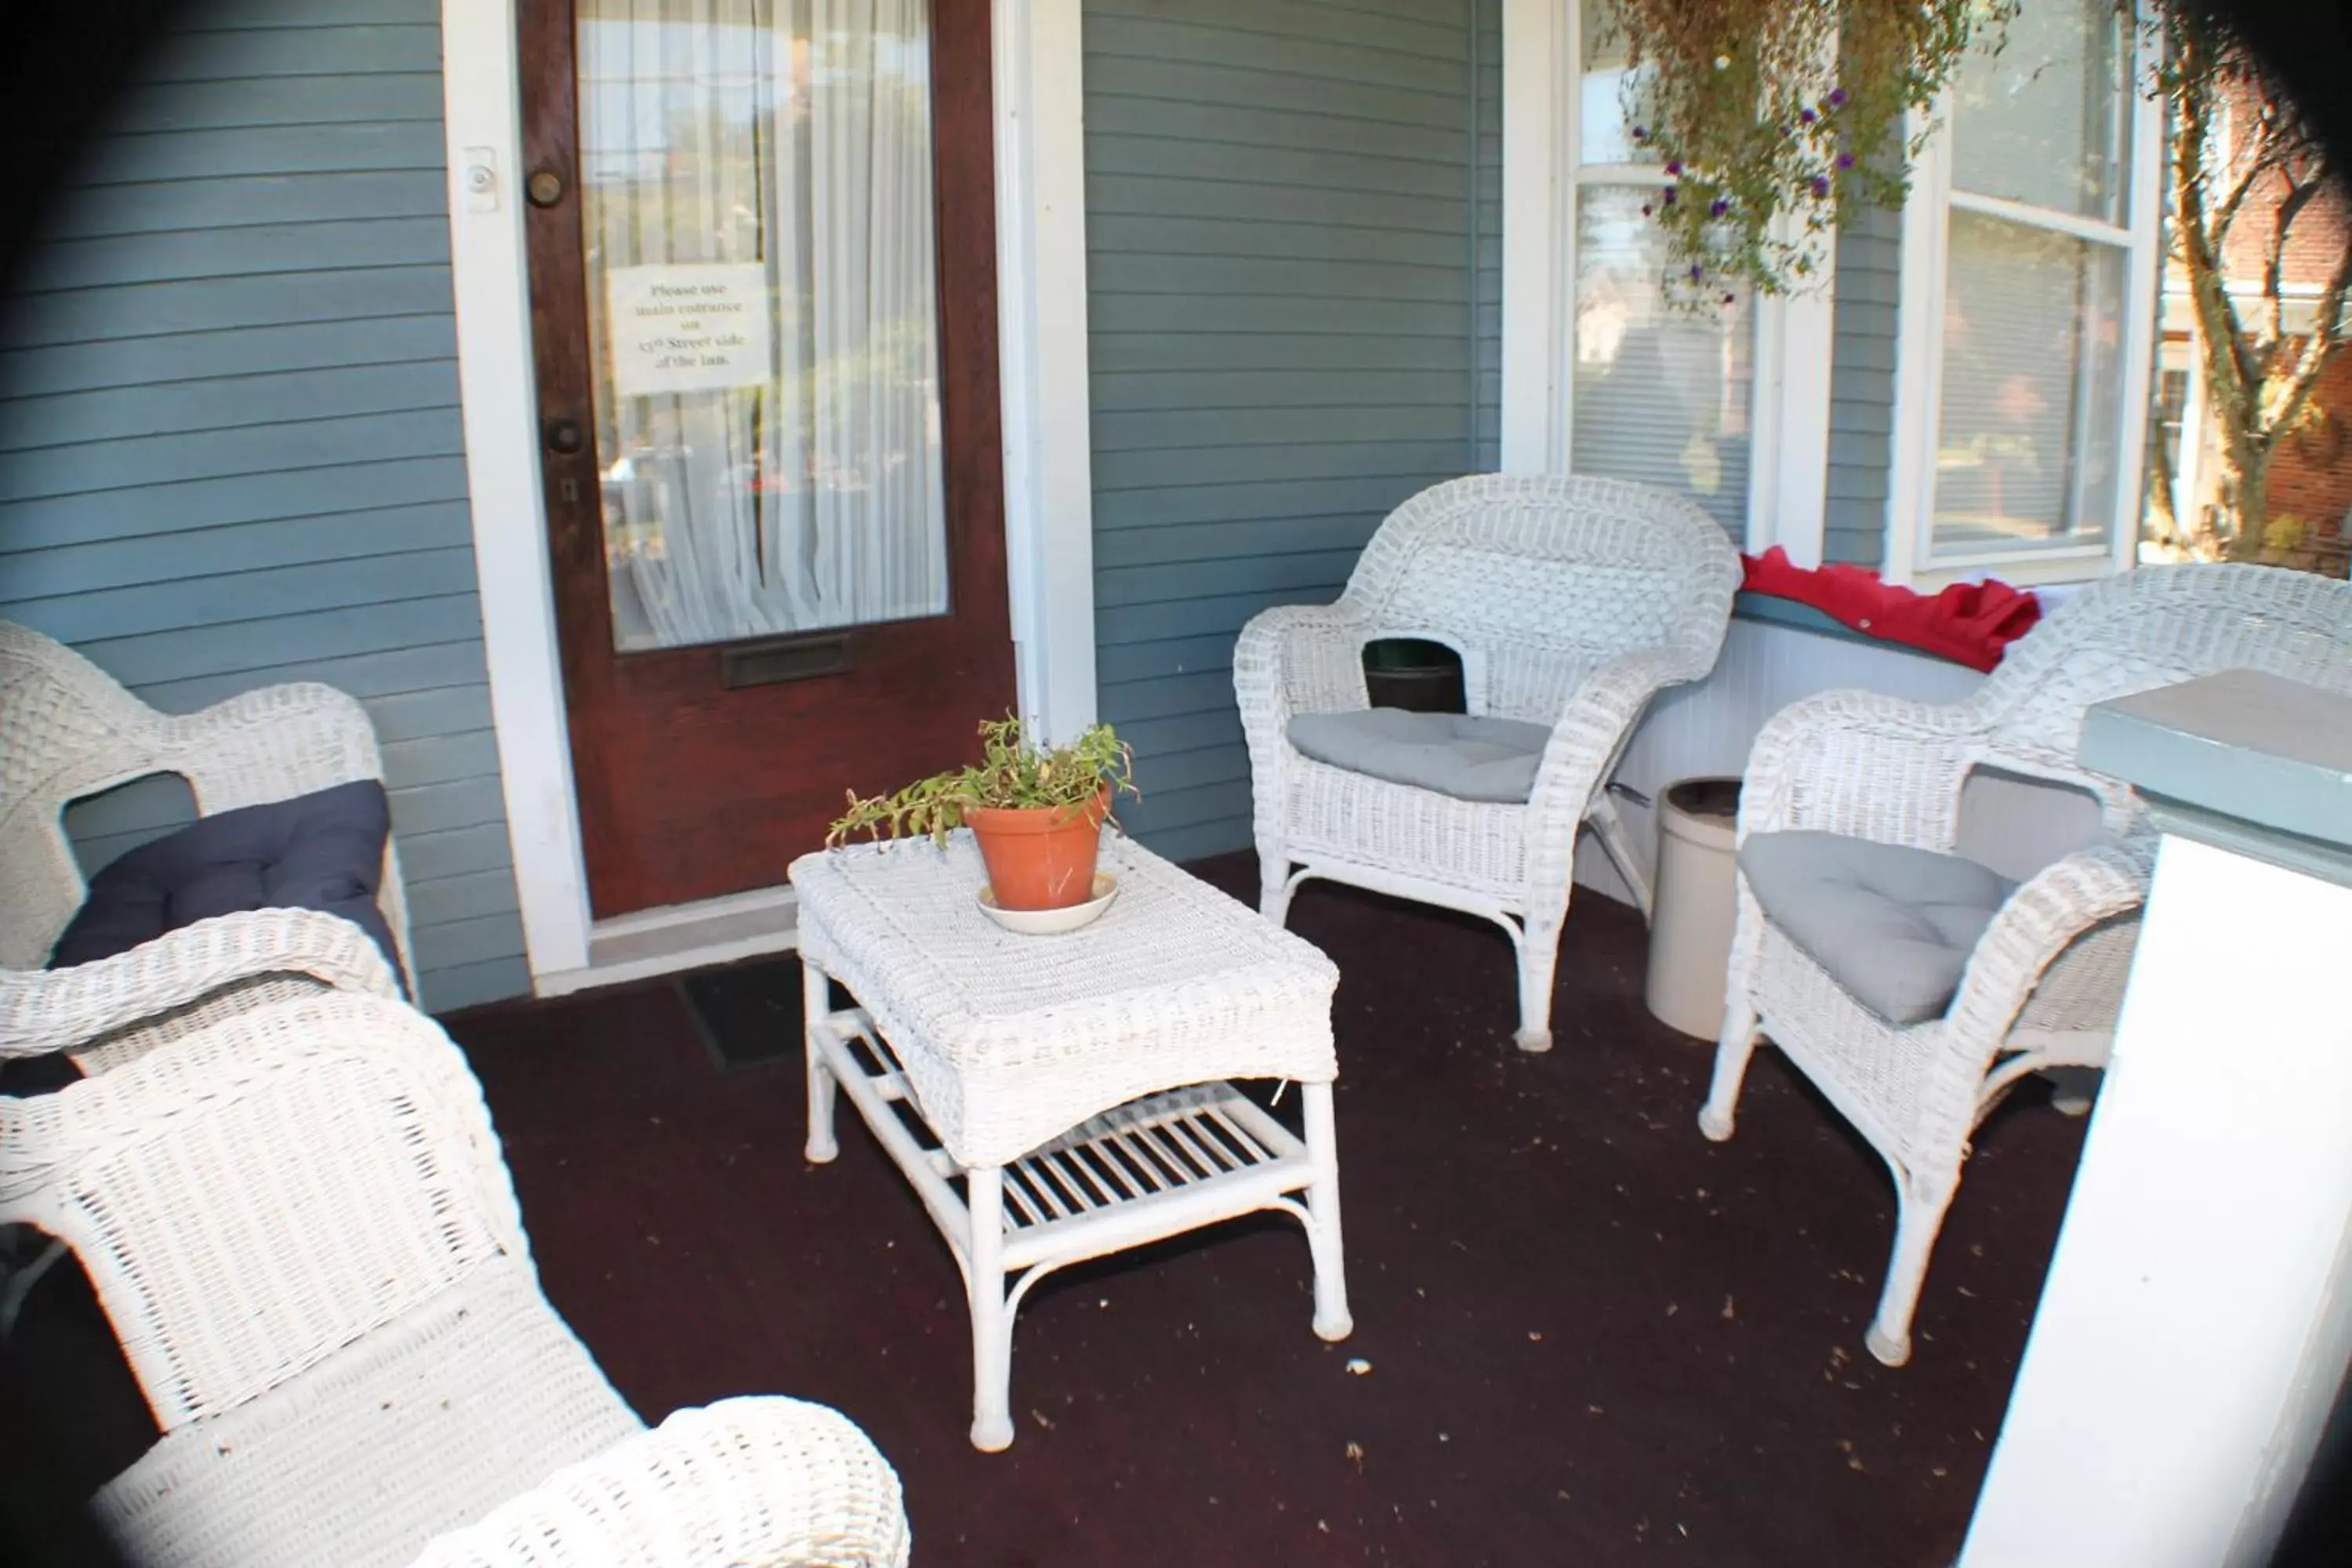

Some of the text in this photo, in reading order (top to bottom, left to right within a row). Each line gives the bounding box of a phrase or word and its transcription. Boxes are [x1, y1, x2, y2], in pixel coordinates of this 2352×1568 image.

[650, 283, 728, 296] Please use
[635, 303, 742, 316] main entrance
[666, 336, 712, 349] Street
[715, 333, 746, 346] side
[673, 354, 696, 367] the
